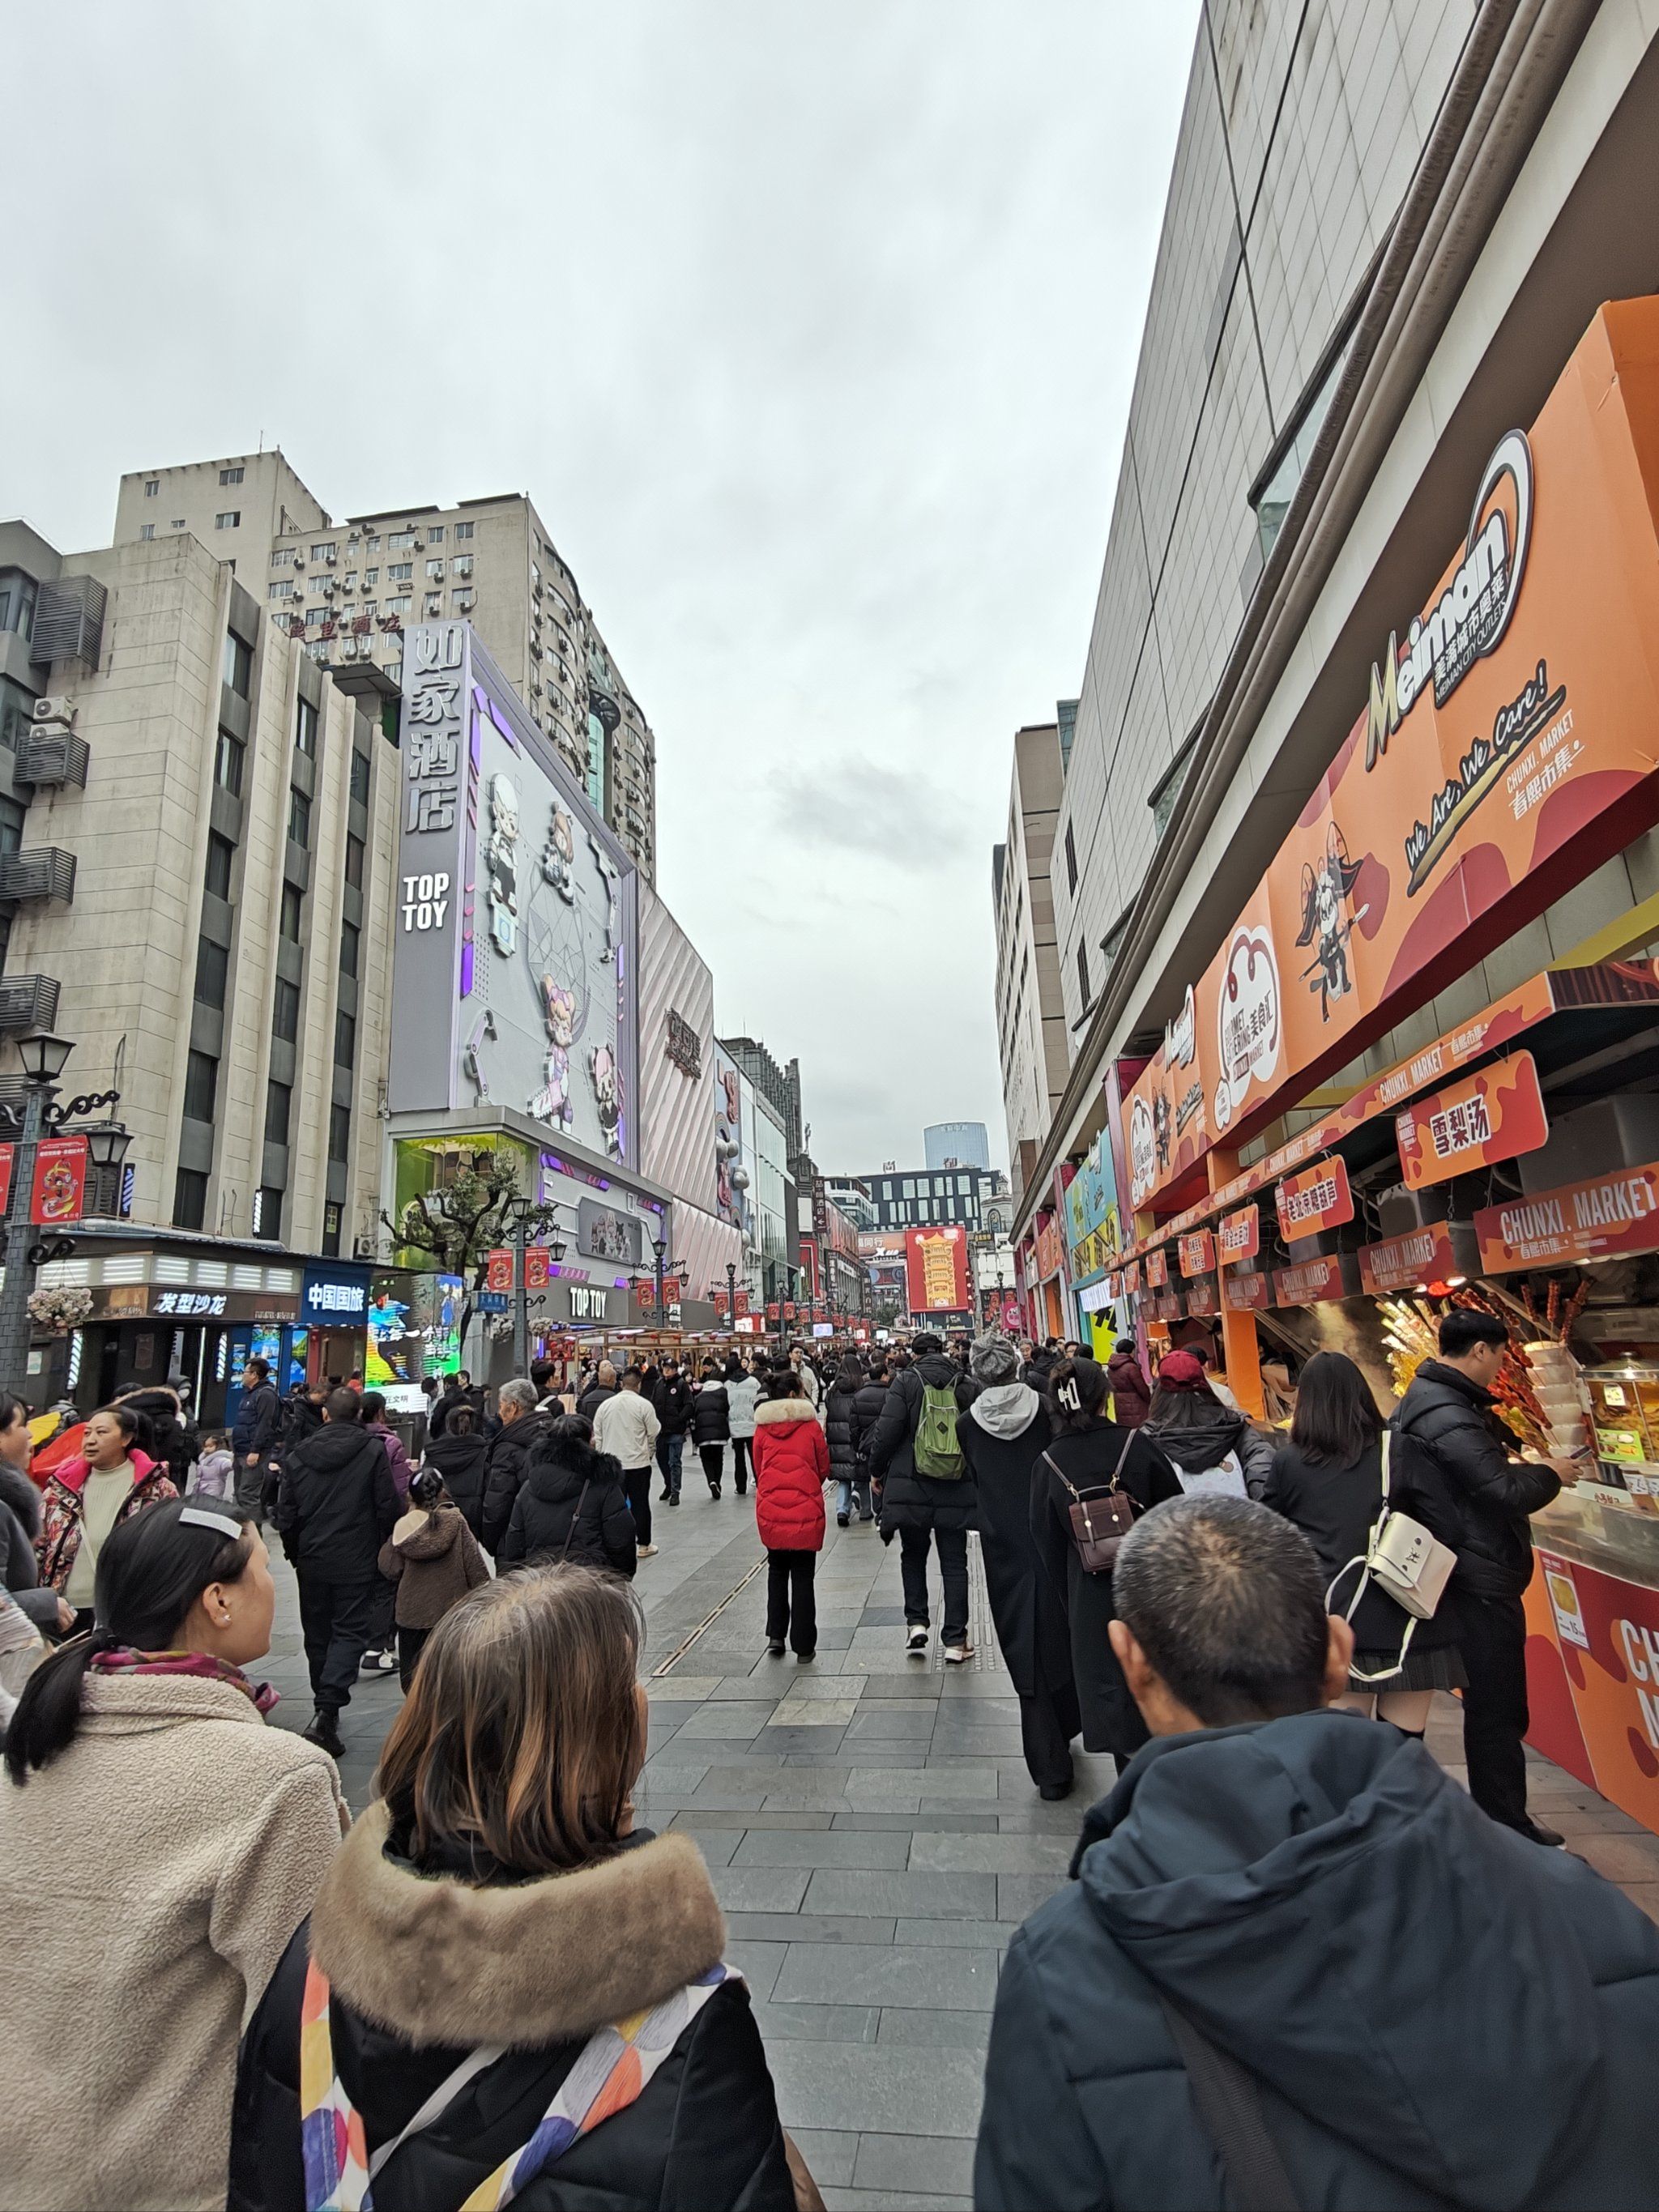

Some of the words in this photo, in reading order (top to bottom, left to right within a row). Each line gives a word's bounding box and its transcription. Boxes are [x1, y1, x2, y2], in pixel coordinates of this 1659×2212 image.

[1366, 511, 1507, 772] Meiman
[1435, 659, 1463, 702] MEIMAN
[1462, 637, 1477, 667] CITY
[405, 624, 463, 835] 如家酒店
[1539, 708, 1574, 760] MARKET
[1406, 825, 1427, 867] We
[1462, 743, 1489, 785] We
[403, 872, 450, 904] TOP
[401, 899, 450, 932] TOY
[1410, 1046, 1444, 1086] MARKET
[1431, 1095, 1491, 1157] 雪梨汤
[1287, 1178, 1337, 1222] 老北京糖葫芦
[1572, 1177, 1657, 1230] MARKET
[1401, 1234, 1437, 1268] MARKET
[156, 1293, 228, 1315] 发型沙龙
[307, 1282, 365, 1313] 中国国旅
[569, 1286, 590, 1318] TOP
[589, 1289, 607, 1319] TOY
